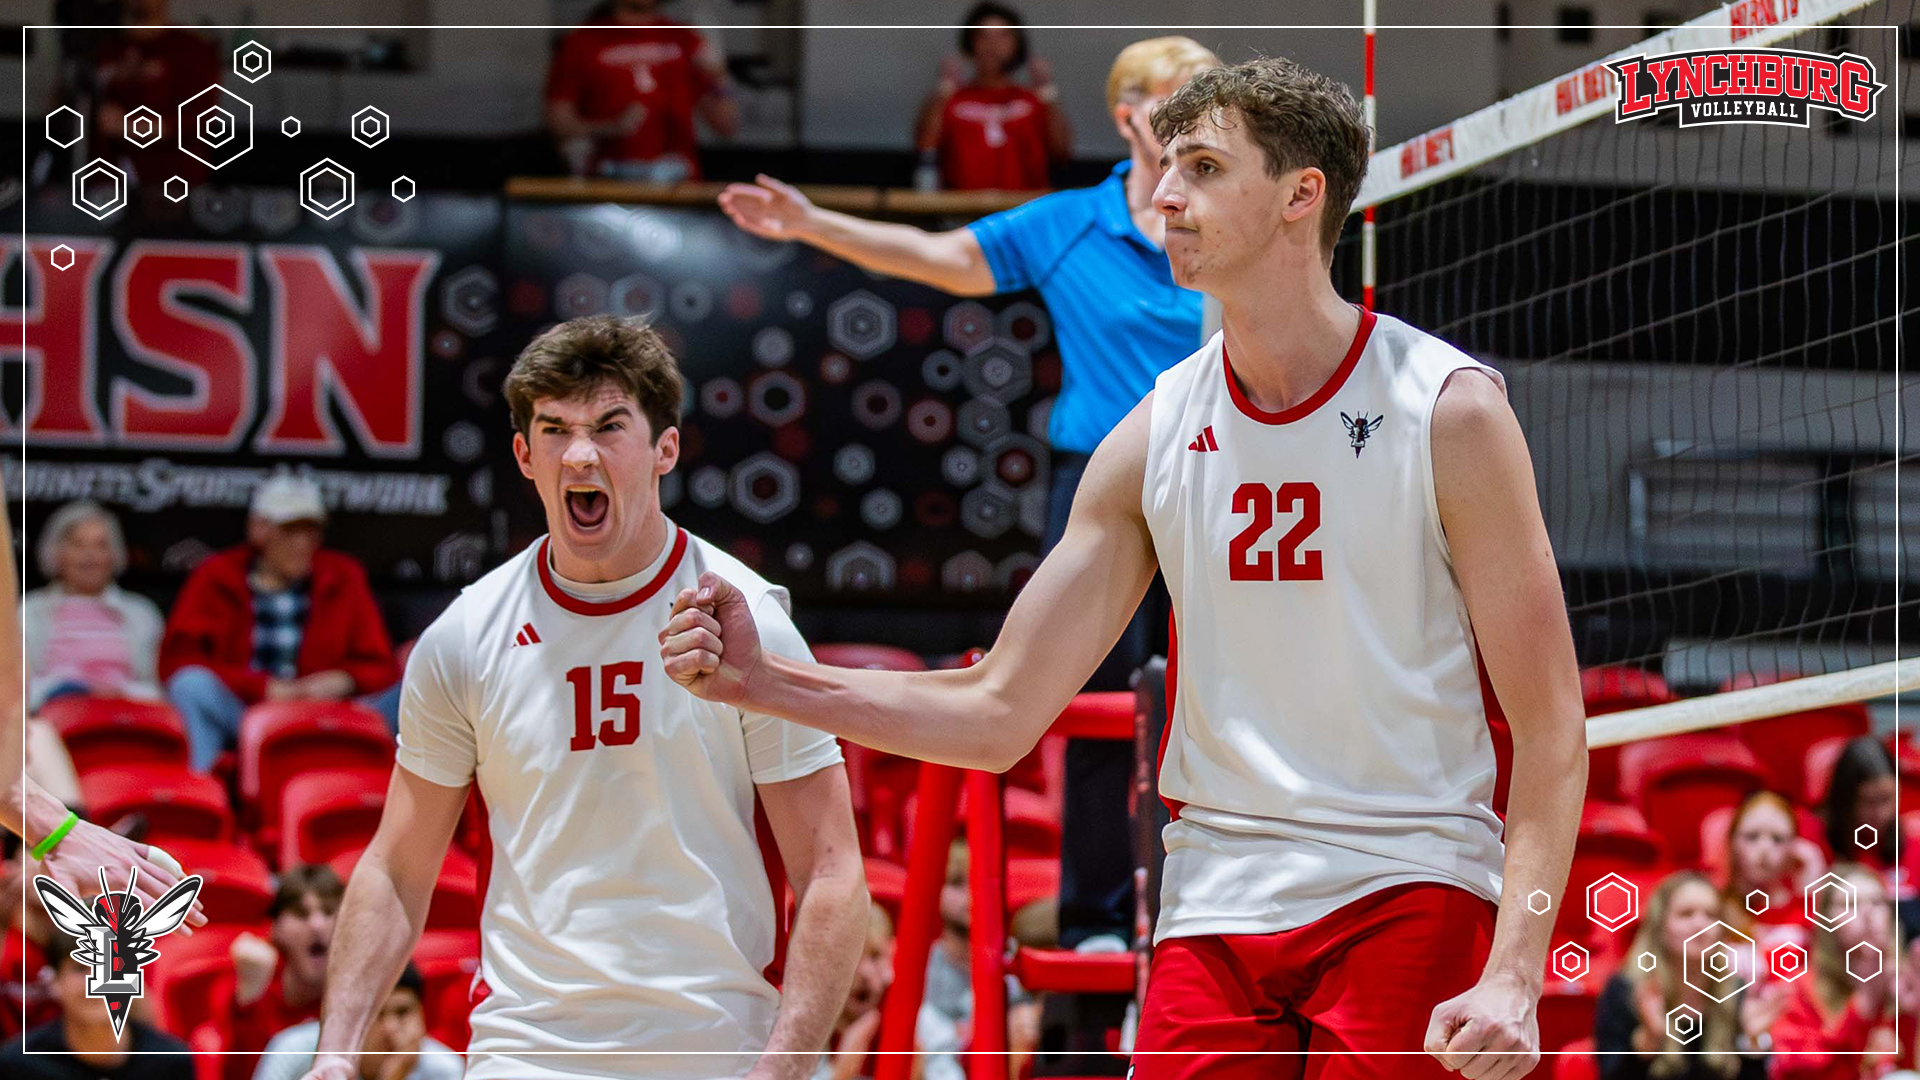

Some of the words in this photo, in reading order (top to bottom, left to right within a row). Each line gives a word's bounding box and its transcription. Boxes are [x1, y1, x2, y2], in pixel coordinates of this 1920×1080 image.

[0, 235, 440, 459] HSN
[1229, 482, 1324, 581] 22
[566, 661, 644, 751] 15
